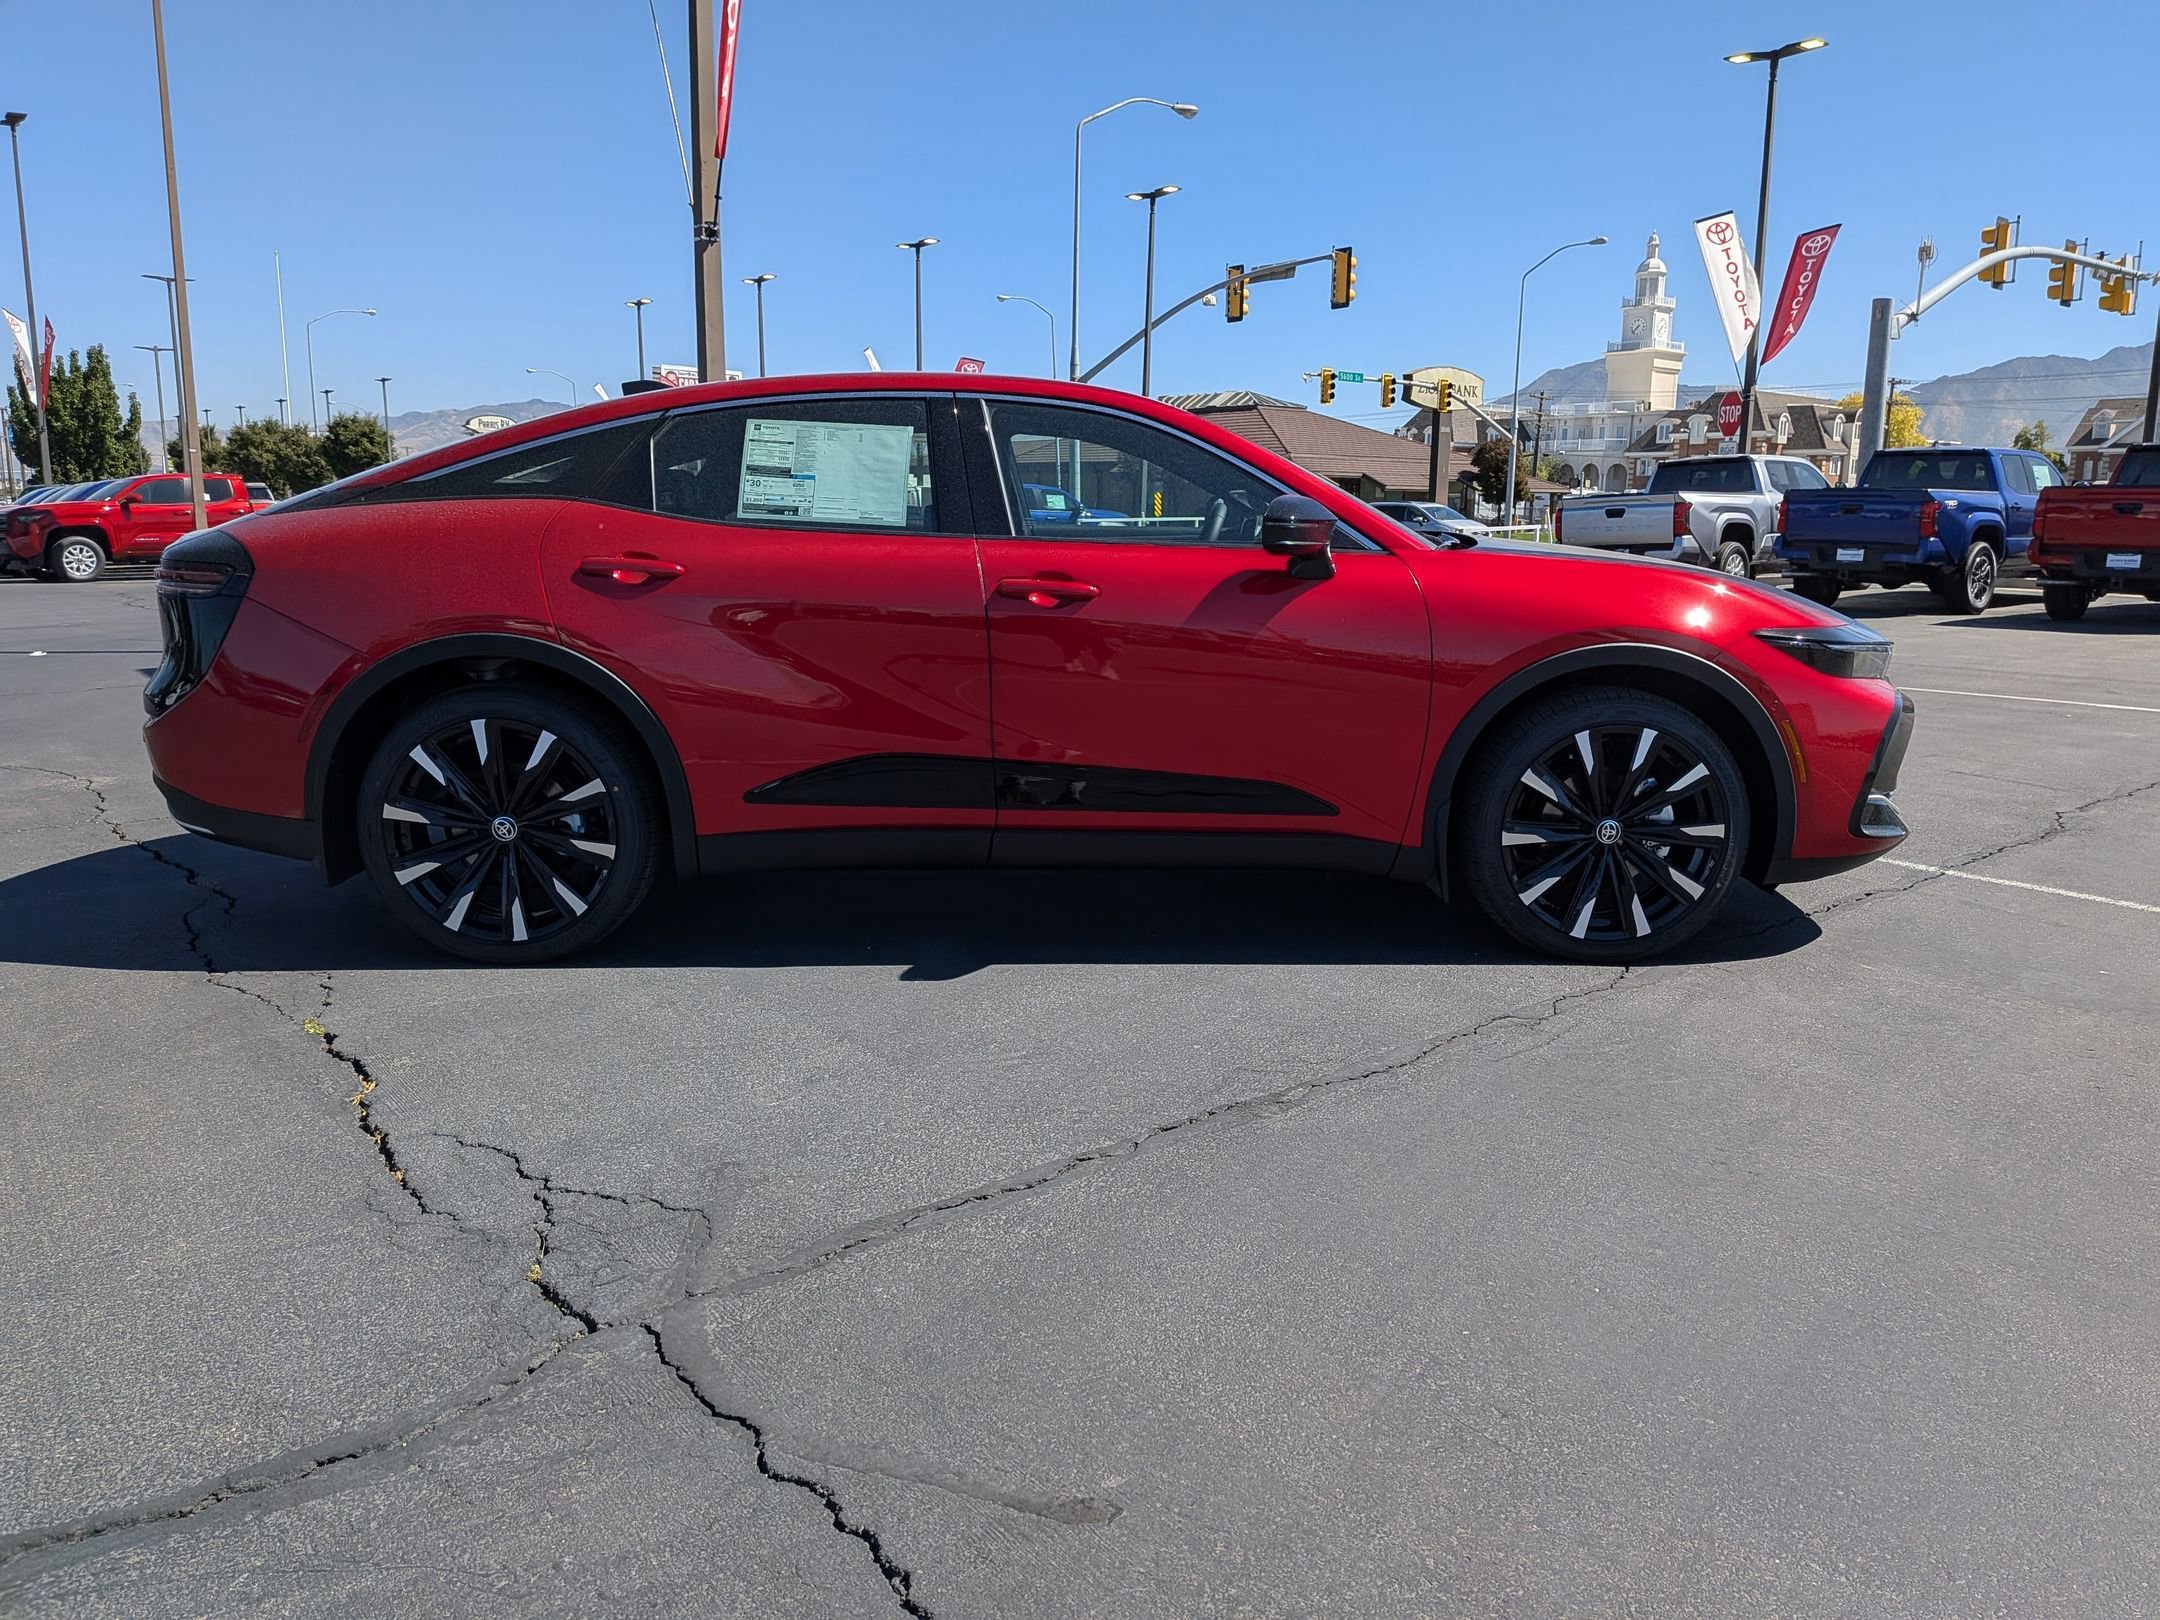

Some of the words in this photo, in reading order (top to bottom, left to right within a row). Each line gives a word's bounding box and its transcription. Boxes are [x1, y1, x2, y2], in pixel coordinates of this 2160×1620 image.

[1721, 247, 1755, 331] TOYOTA
[1783, 258, 1817, 336] TOYOTA
[1452, 383, 1478, 399] BANK
[1720, 405, 1742, 424] STOP
[1720, 445, 1736, 455] RIGHT
[749, 479, 761, 487] 30
